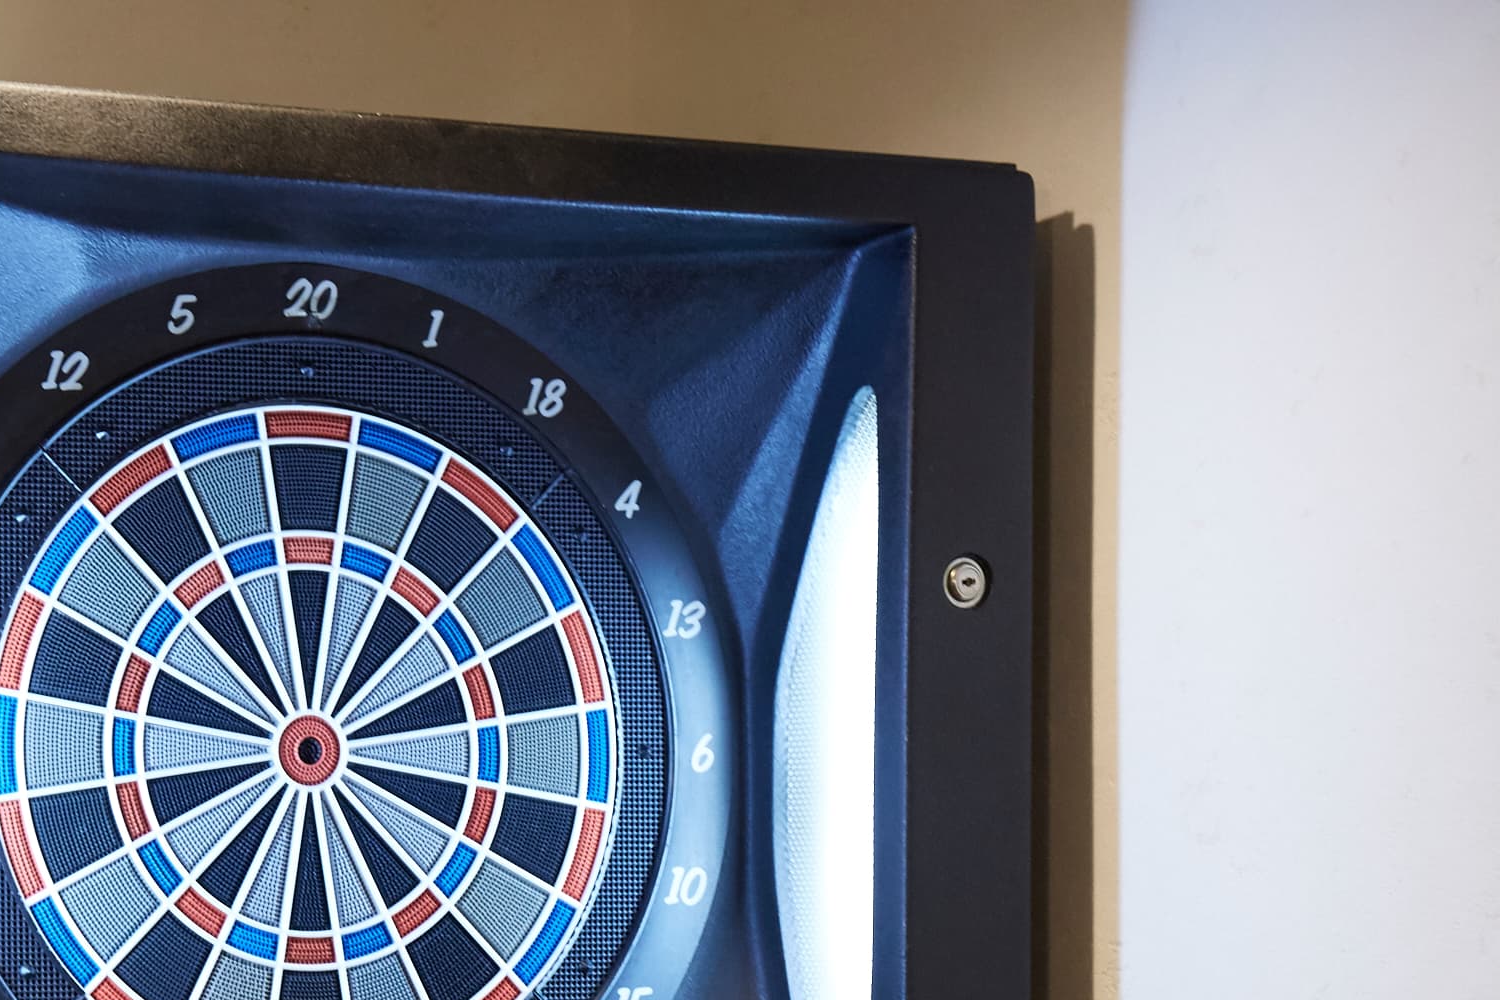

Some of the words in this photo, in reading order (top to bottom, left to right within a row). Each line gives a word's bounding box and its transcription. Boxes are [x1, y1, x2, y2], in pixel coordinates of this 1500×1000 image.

[167, 294, 197, 335] 5
[282, 278, 338, 320] 20
[421, 309, 444, 348] 1
[41, 350, 90, 391] 12
[522, 377, 567, 418] 18
[614, 479, 643, 519] 4
[662, 599, 706, 640] 13
[691, 733, 715, 773] 6
[664, 866, 708, 906] 10
